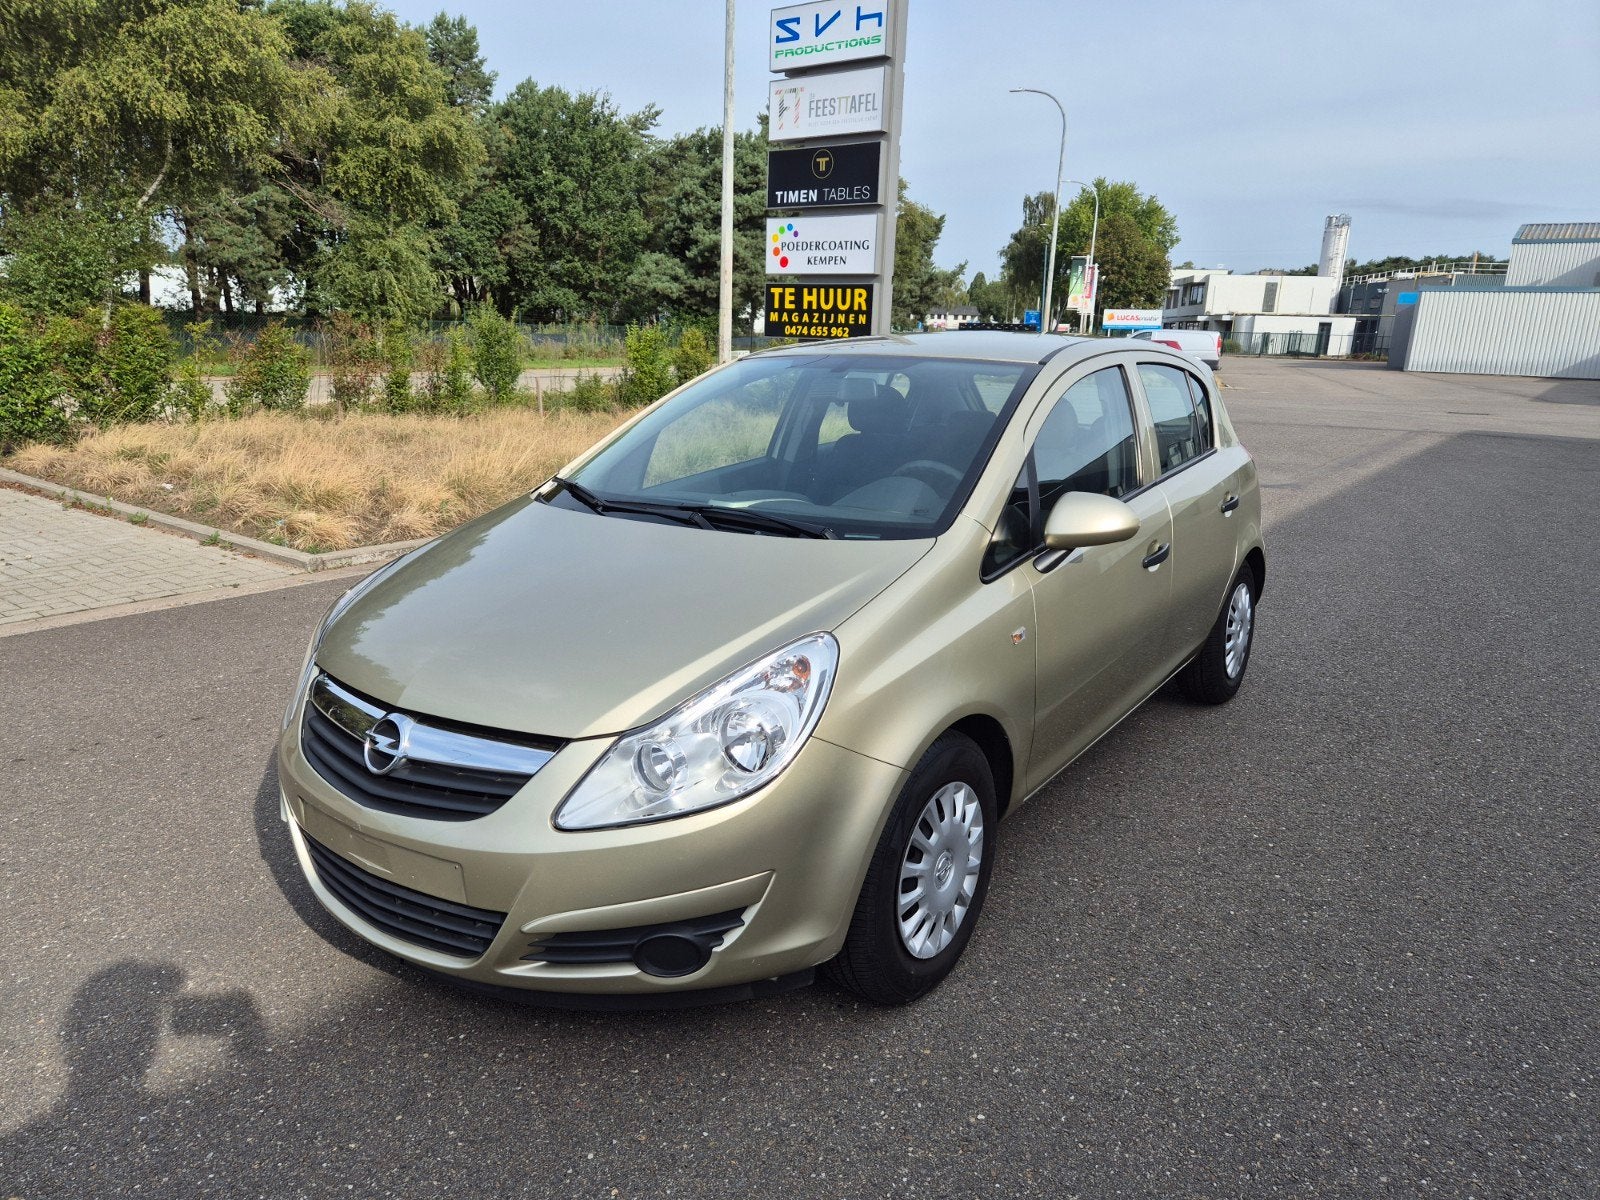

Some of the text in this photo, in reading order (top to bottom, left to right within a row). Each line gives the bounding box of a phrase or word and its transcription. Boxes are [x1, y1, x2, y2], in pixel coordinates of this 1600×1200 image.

[808, 93, 878, 118] FEESTTAFEL
[775, 185, 871, 204] TIMEN TABLES
[781, 239, 870, 251] POEDERCOATING
[807, 256, 847, 266] KEMPEN
[770, 287, 868, 311] TE HUUR
[769, 311, 867, 325] MAGAZIJNEN
[784, 324, 850, 338] 0474 655 962
